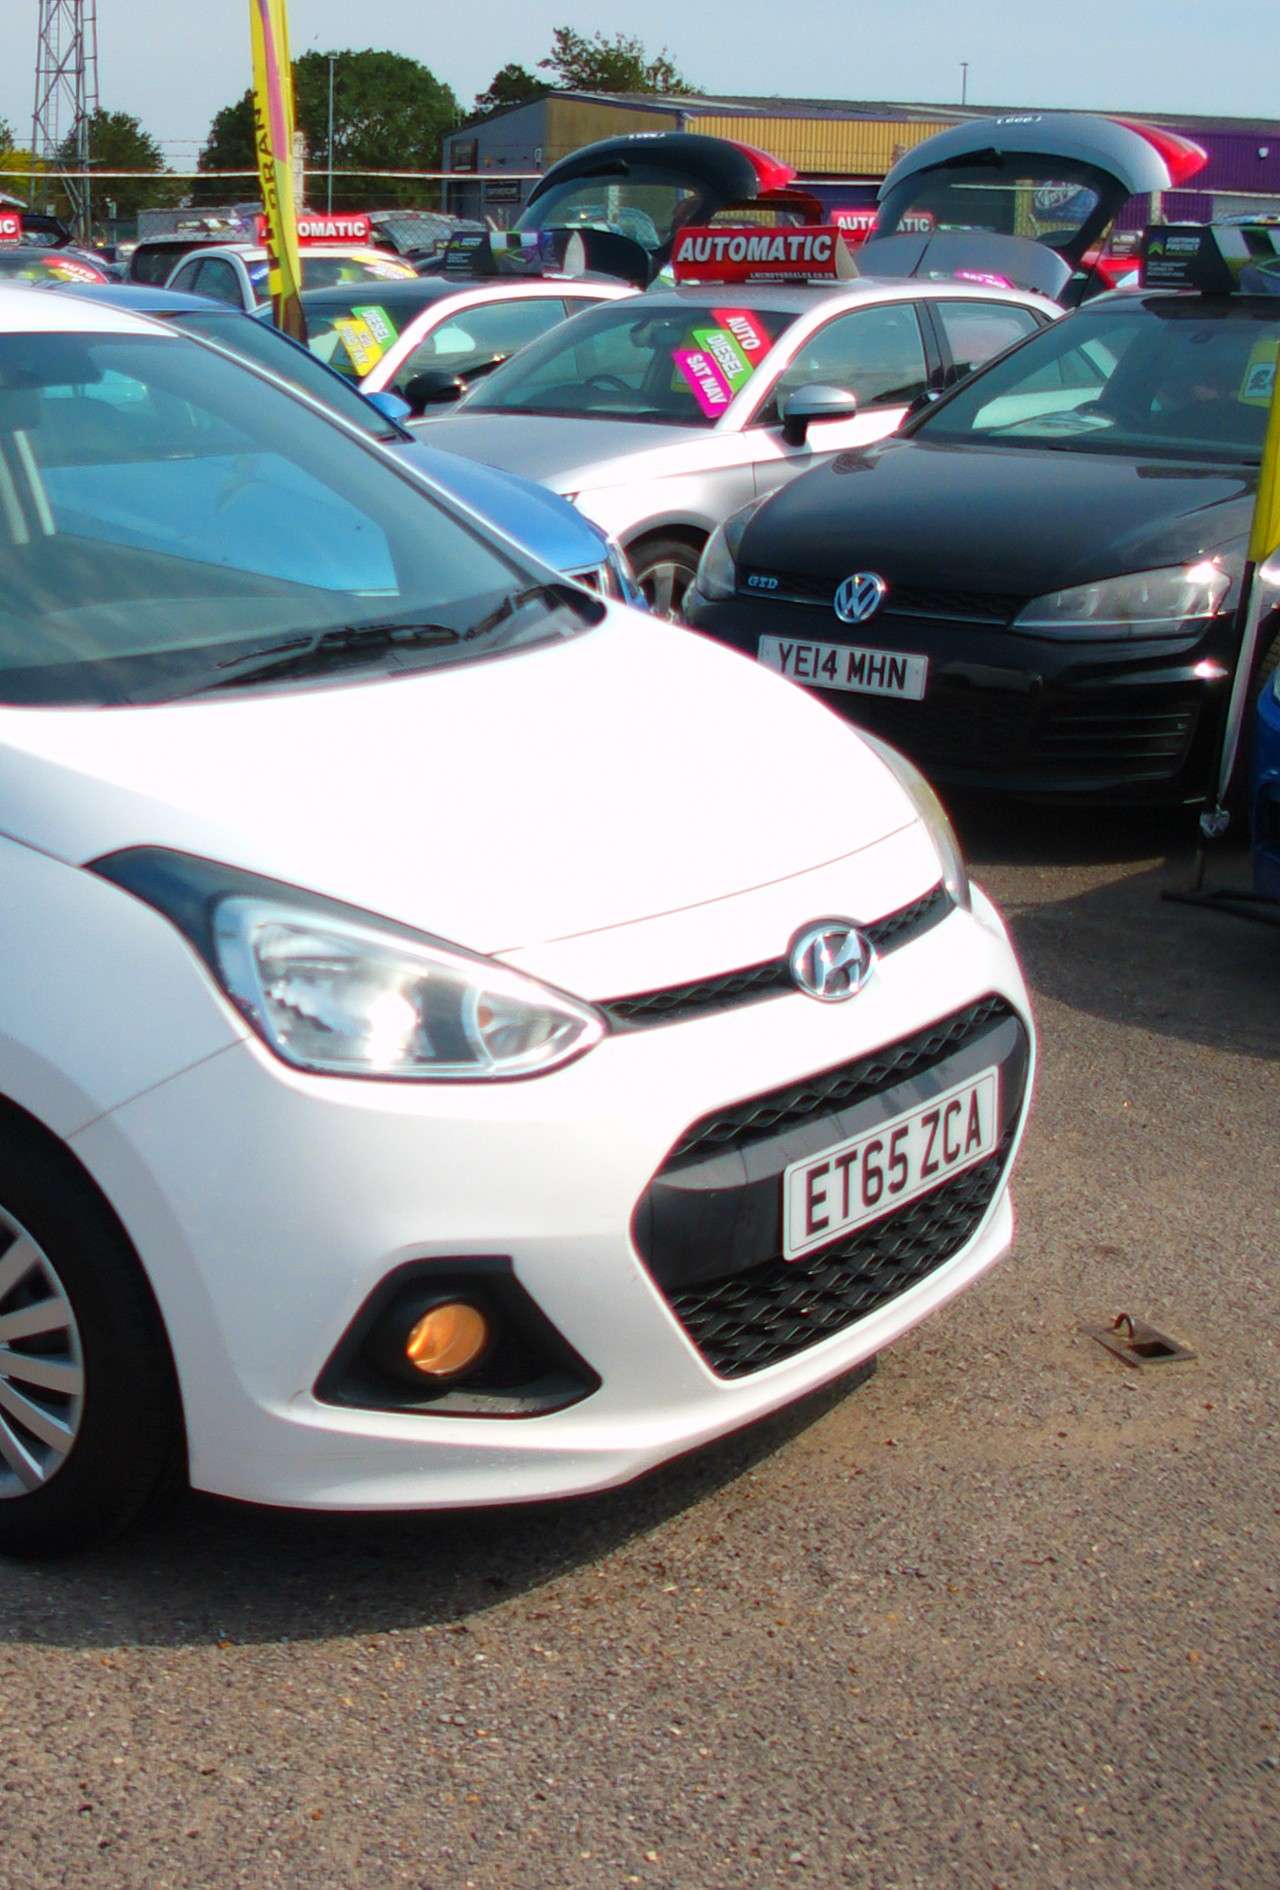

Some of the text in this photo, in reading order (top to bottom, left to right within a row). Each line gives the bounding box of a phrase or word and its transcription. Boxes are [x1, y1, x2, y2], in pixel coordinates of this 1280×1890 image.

[677, 235, 833, 262] AUTOMATIC
[726, 316, 761, 350] AUTO
[686, 353, 728, 404] SAT NAV
[706, 334, 745, 380] DIESEL
[747, 574, 779, 590] GTD
[778, 642, 908, 691] YE14 MHN
[806, 1088, 982, 1237] ET65 ZCA
